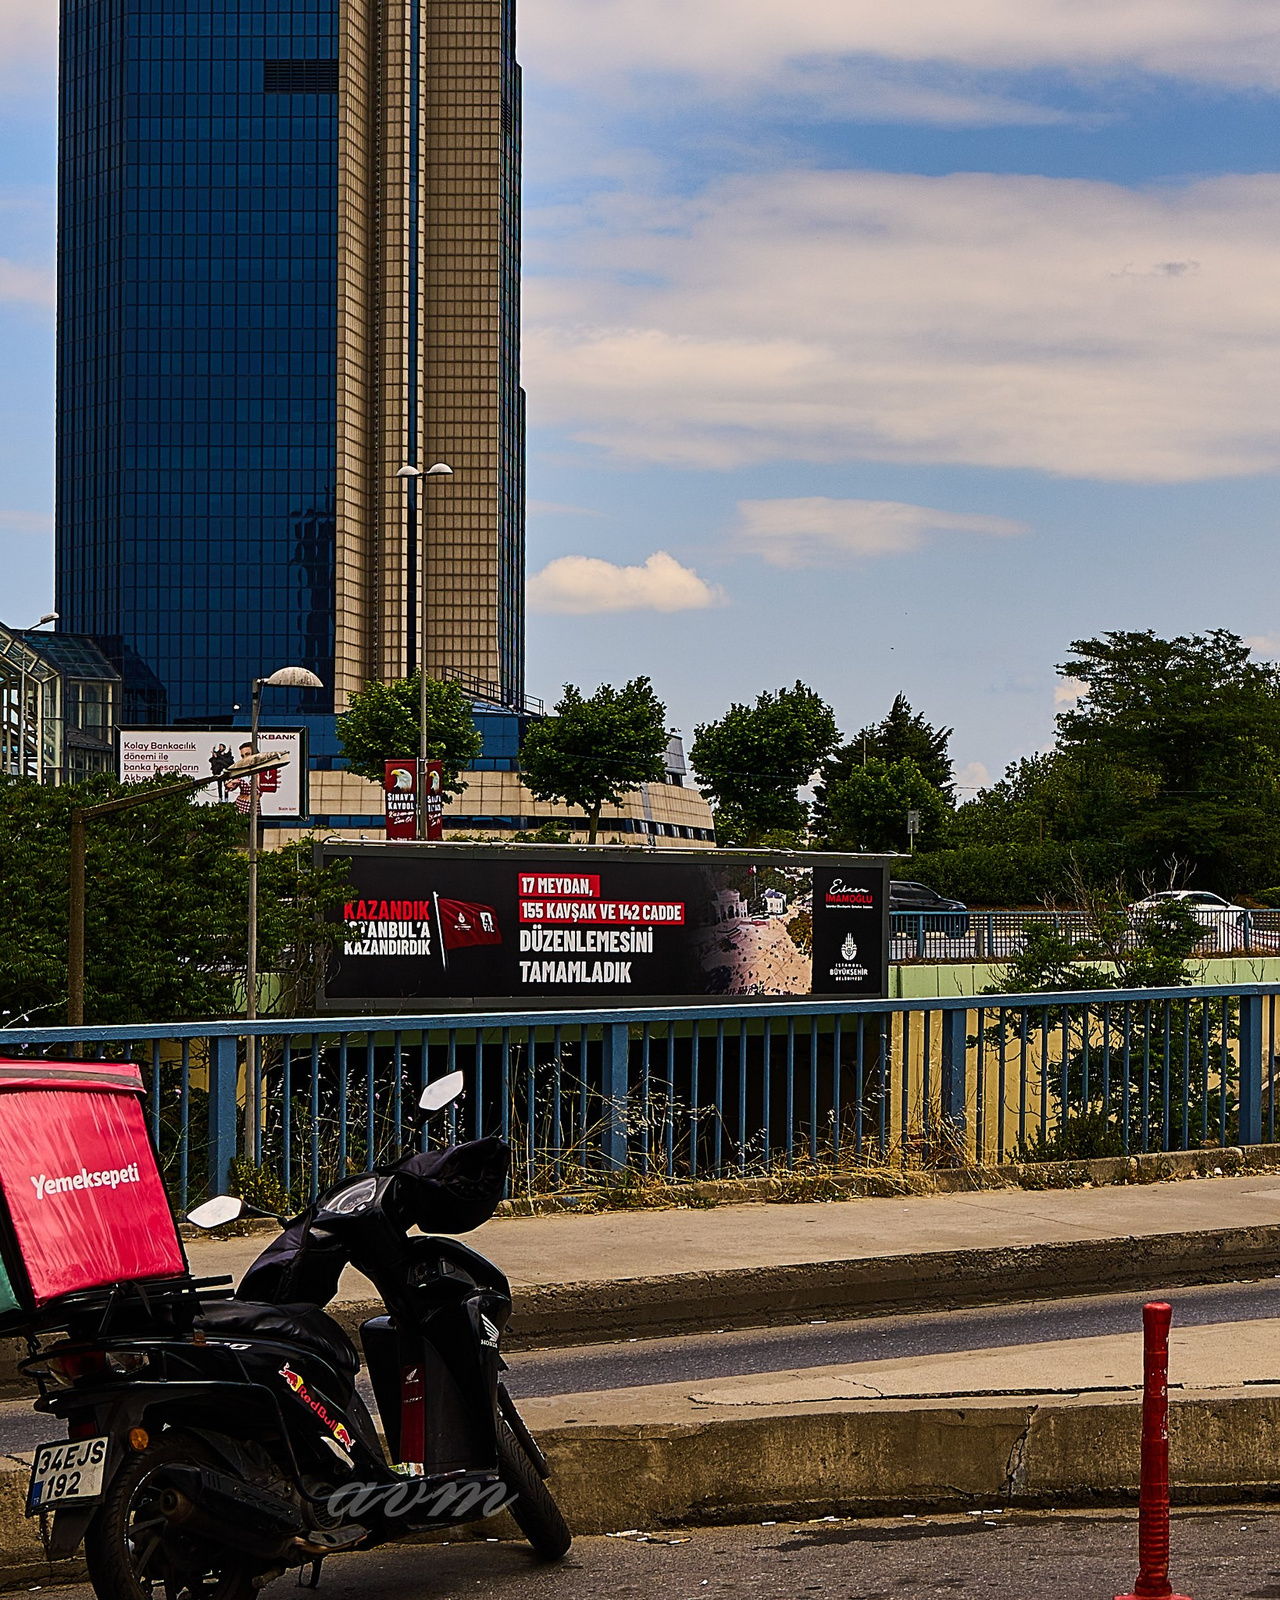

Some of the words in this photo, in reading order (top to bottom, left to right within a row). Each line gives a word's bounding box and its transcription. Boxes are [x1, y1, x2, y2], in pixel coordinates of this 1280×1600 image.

[124, 742, 149, 751] Kolay
[154, 763, 199, 772] hesapların
[522, 877, 535, 893] 17
[538, 878, 593, 896] MEYDAN,
[825, 892, 873, 903] İMAMOĞLU
[344, 900, 430, 920] KAZANDIK
[522, 903, 543, 918] 155
[546, 903, 597, 922] KAVŞAK
[600, 904, 616, 920] VE
[619, 905, 639, 920] 142
[642, 905, 682, 920] CADDE
[344, 940, 431, 955] KAZANDIRDIK
[519, 924, 653, 953] DÜZENLEMESİNİ
[519, 961, 632, 983] TAMAMLADIK
[30, 1162, 139, 1200] Yemeksepeti
[46, 1471, 81, 1499] 192
